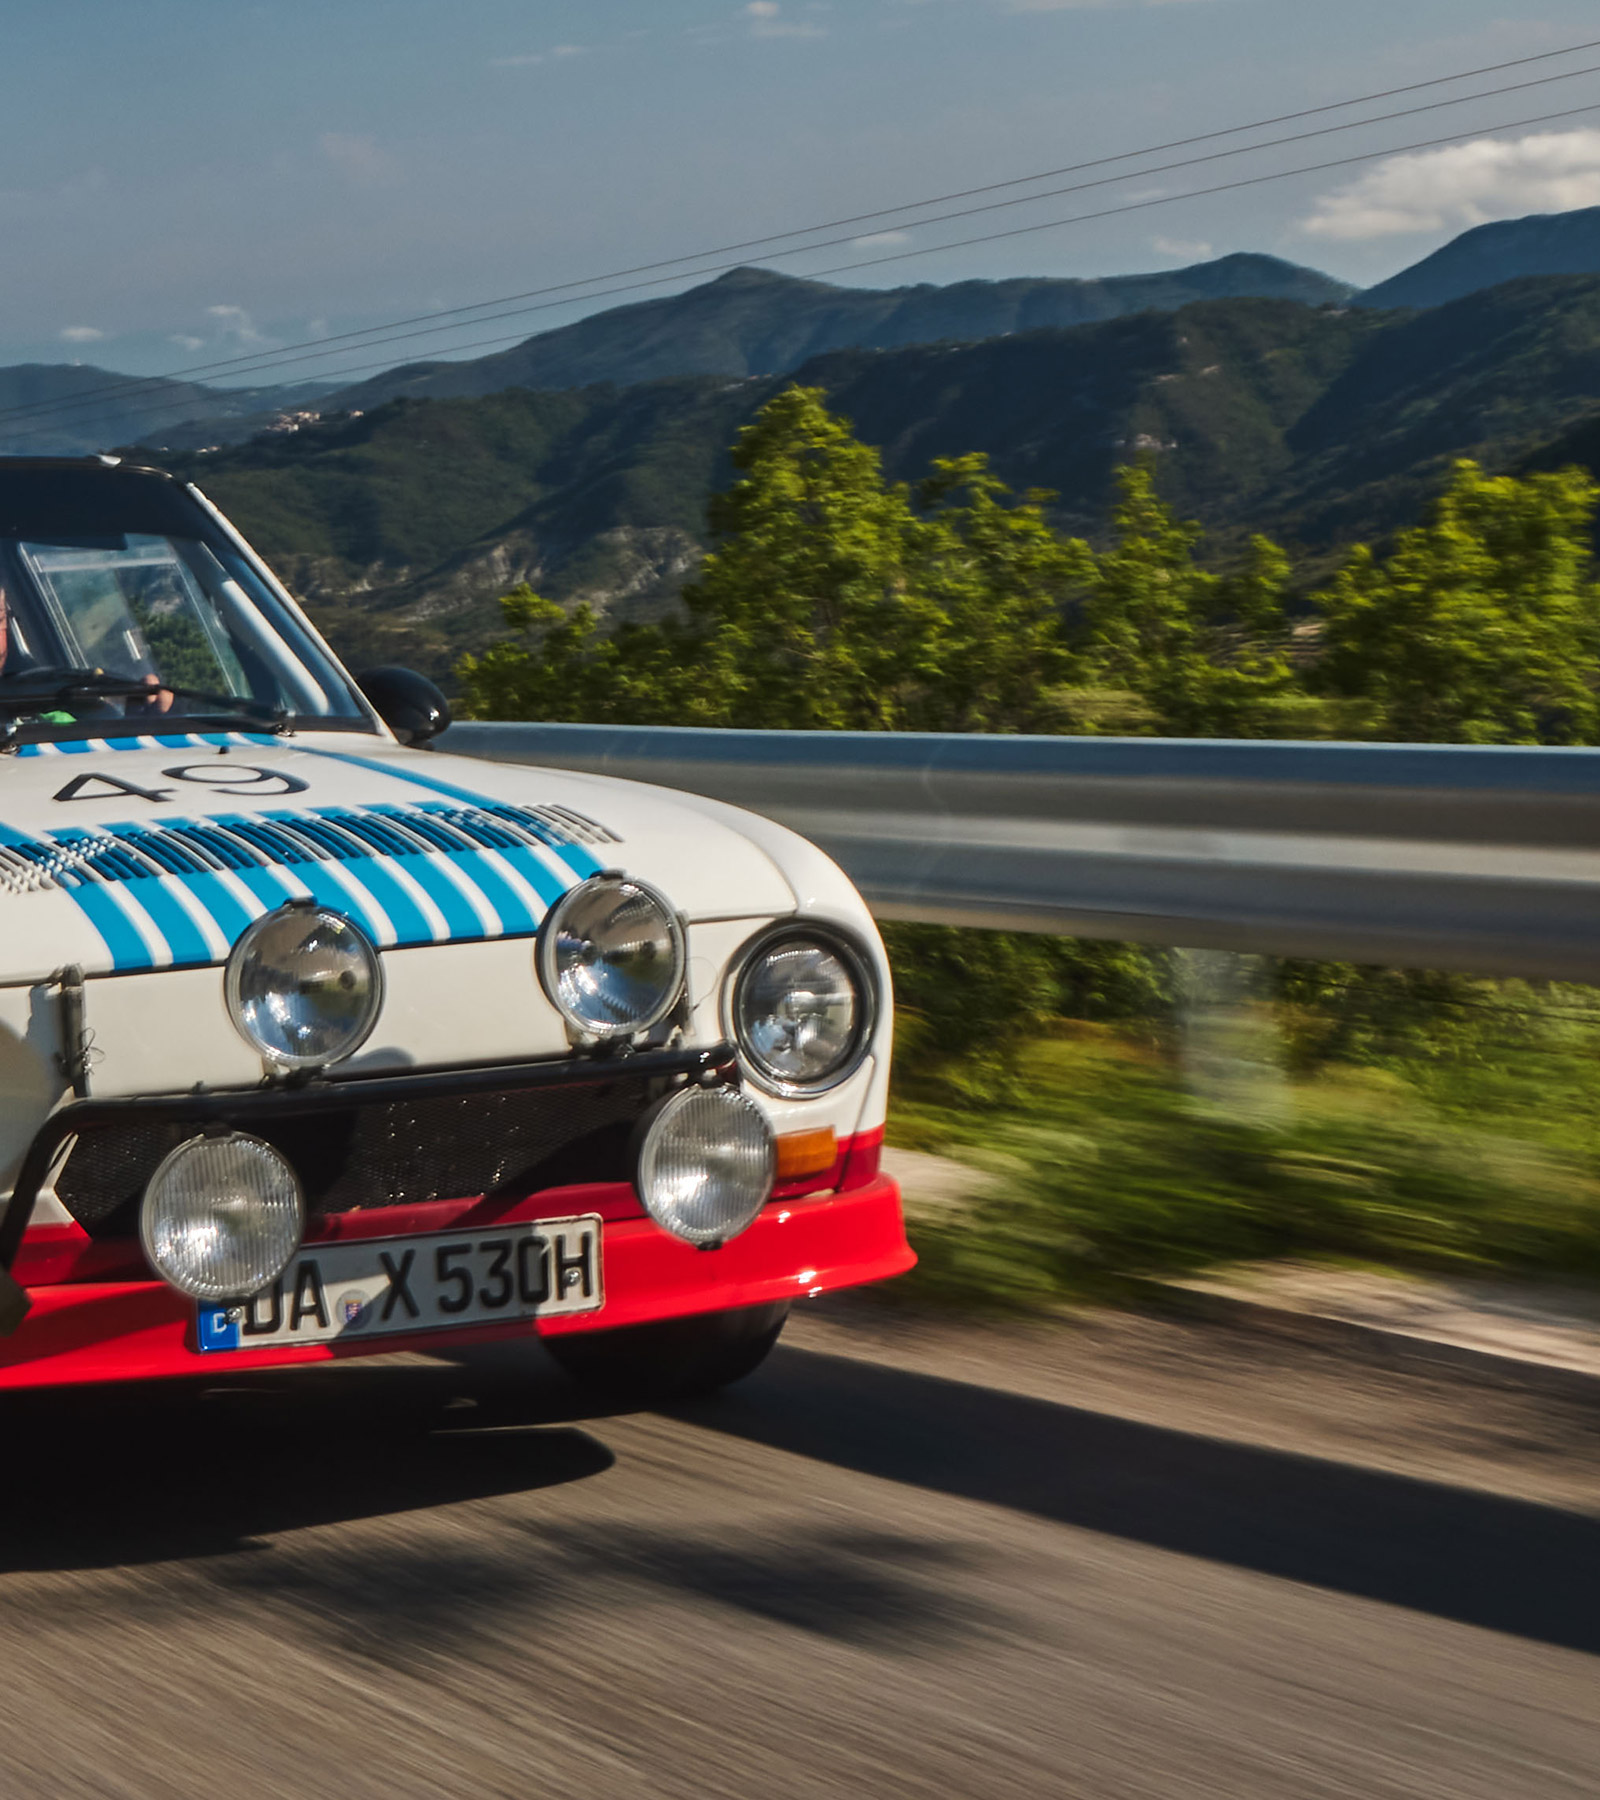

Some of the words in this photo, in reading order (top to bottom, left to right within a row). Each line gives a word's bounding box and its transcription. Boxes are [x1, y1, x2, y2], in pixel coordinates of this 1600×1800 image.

[52, 764, 310, 804] 49
[379, 1249, 420, 1321] X
[437, 1231, 592, 1314] 530H
